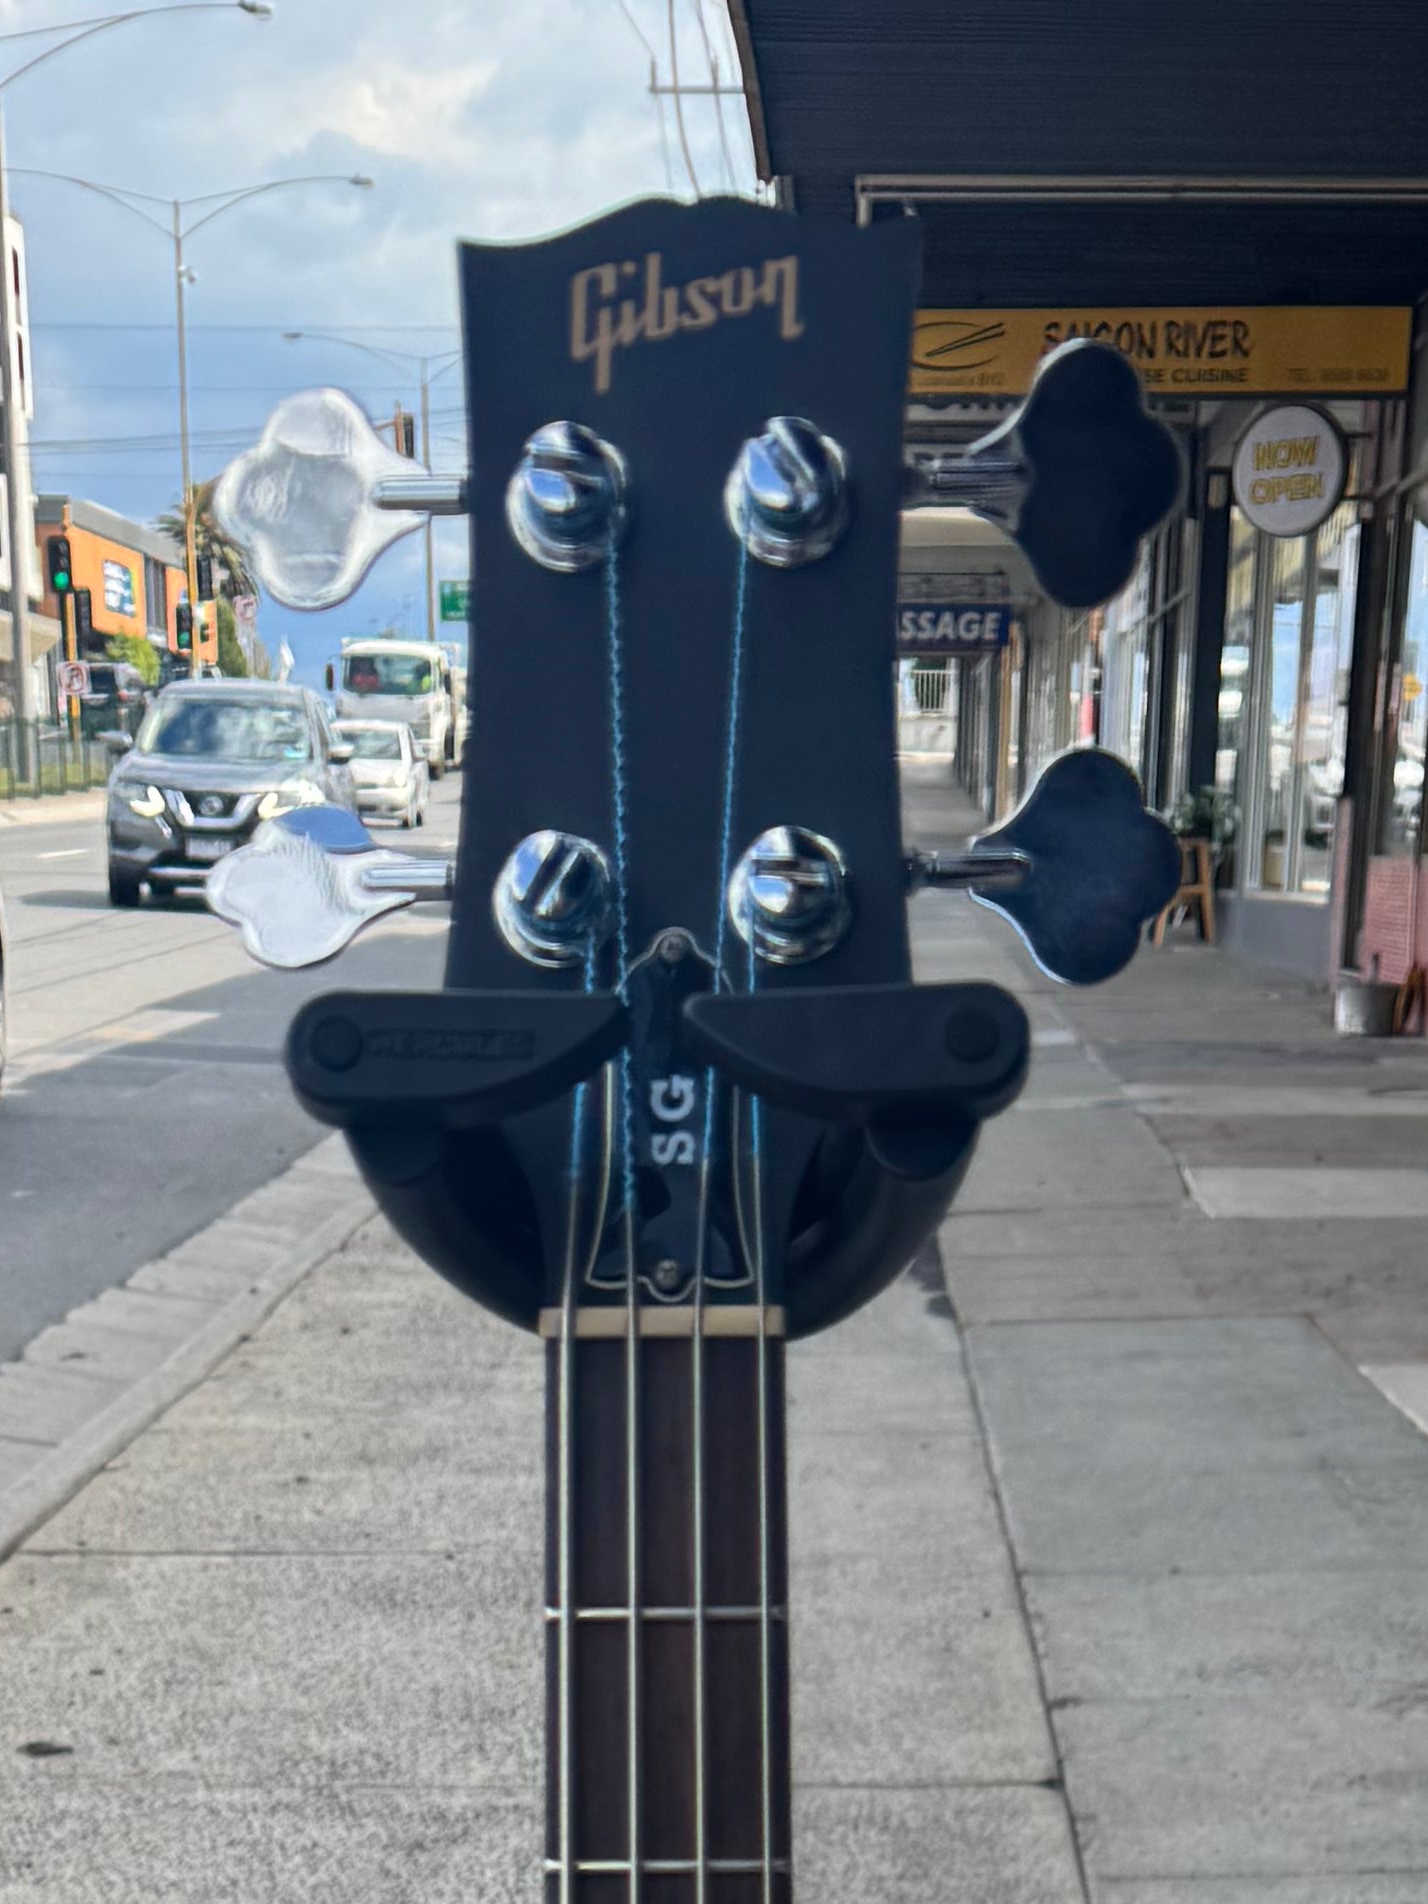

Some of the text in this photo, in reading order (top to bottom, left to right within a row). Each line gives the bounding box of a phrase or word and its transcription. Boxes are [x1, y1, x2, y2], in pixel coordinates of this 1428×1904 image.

[569, 251, 806, 396] Gibson
[1162, 319, 1251, 359] RIVER
[1252, 435, 1320, 471] NOW
[1249, 471, 1325, 505] OPEN
[900, 609, 1002, 641] SSAGE
[650, 1073, 695, 1166] SG
